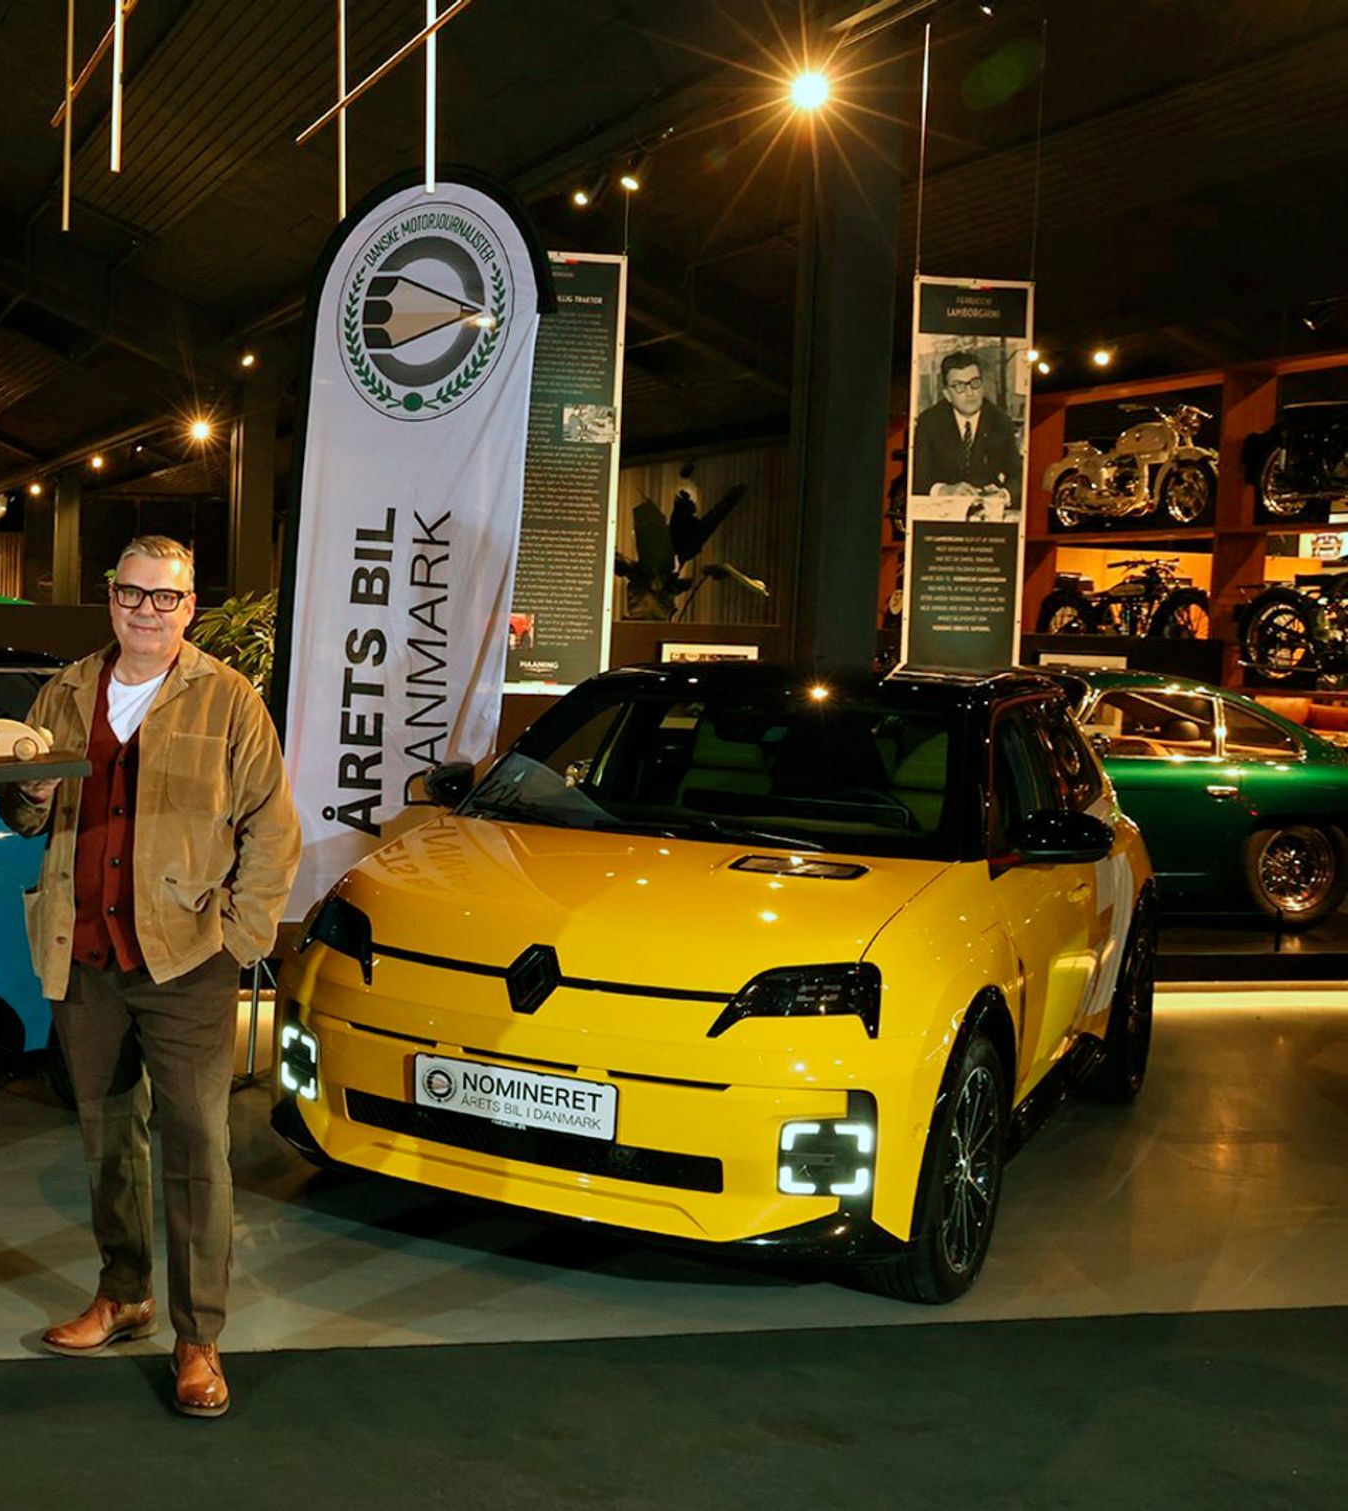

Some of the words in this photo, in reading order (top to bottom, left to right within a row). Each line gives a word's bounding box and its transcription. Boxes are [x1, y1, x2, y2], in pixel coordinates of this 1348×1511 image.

[364, 225, 401, 267] DANSKE
[401, 213, 496, 264] MOTORJOURNALISTER
[946, 307, 1001, 319] LAMBORGHINI
[350, 507, 396, 606] BIL
[404, 510, 452, 807] DANMARK
[322, 628, 387, 838] ÅRETS
[461, 1093, 501, 1113] ÅRETS
[503, 1101, 523, 1118] BIL
[533, 1107, 602, 1131] DANMARK
[462, 1072, 603, 1113] NOMINERET
